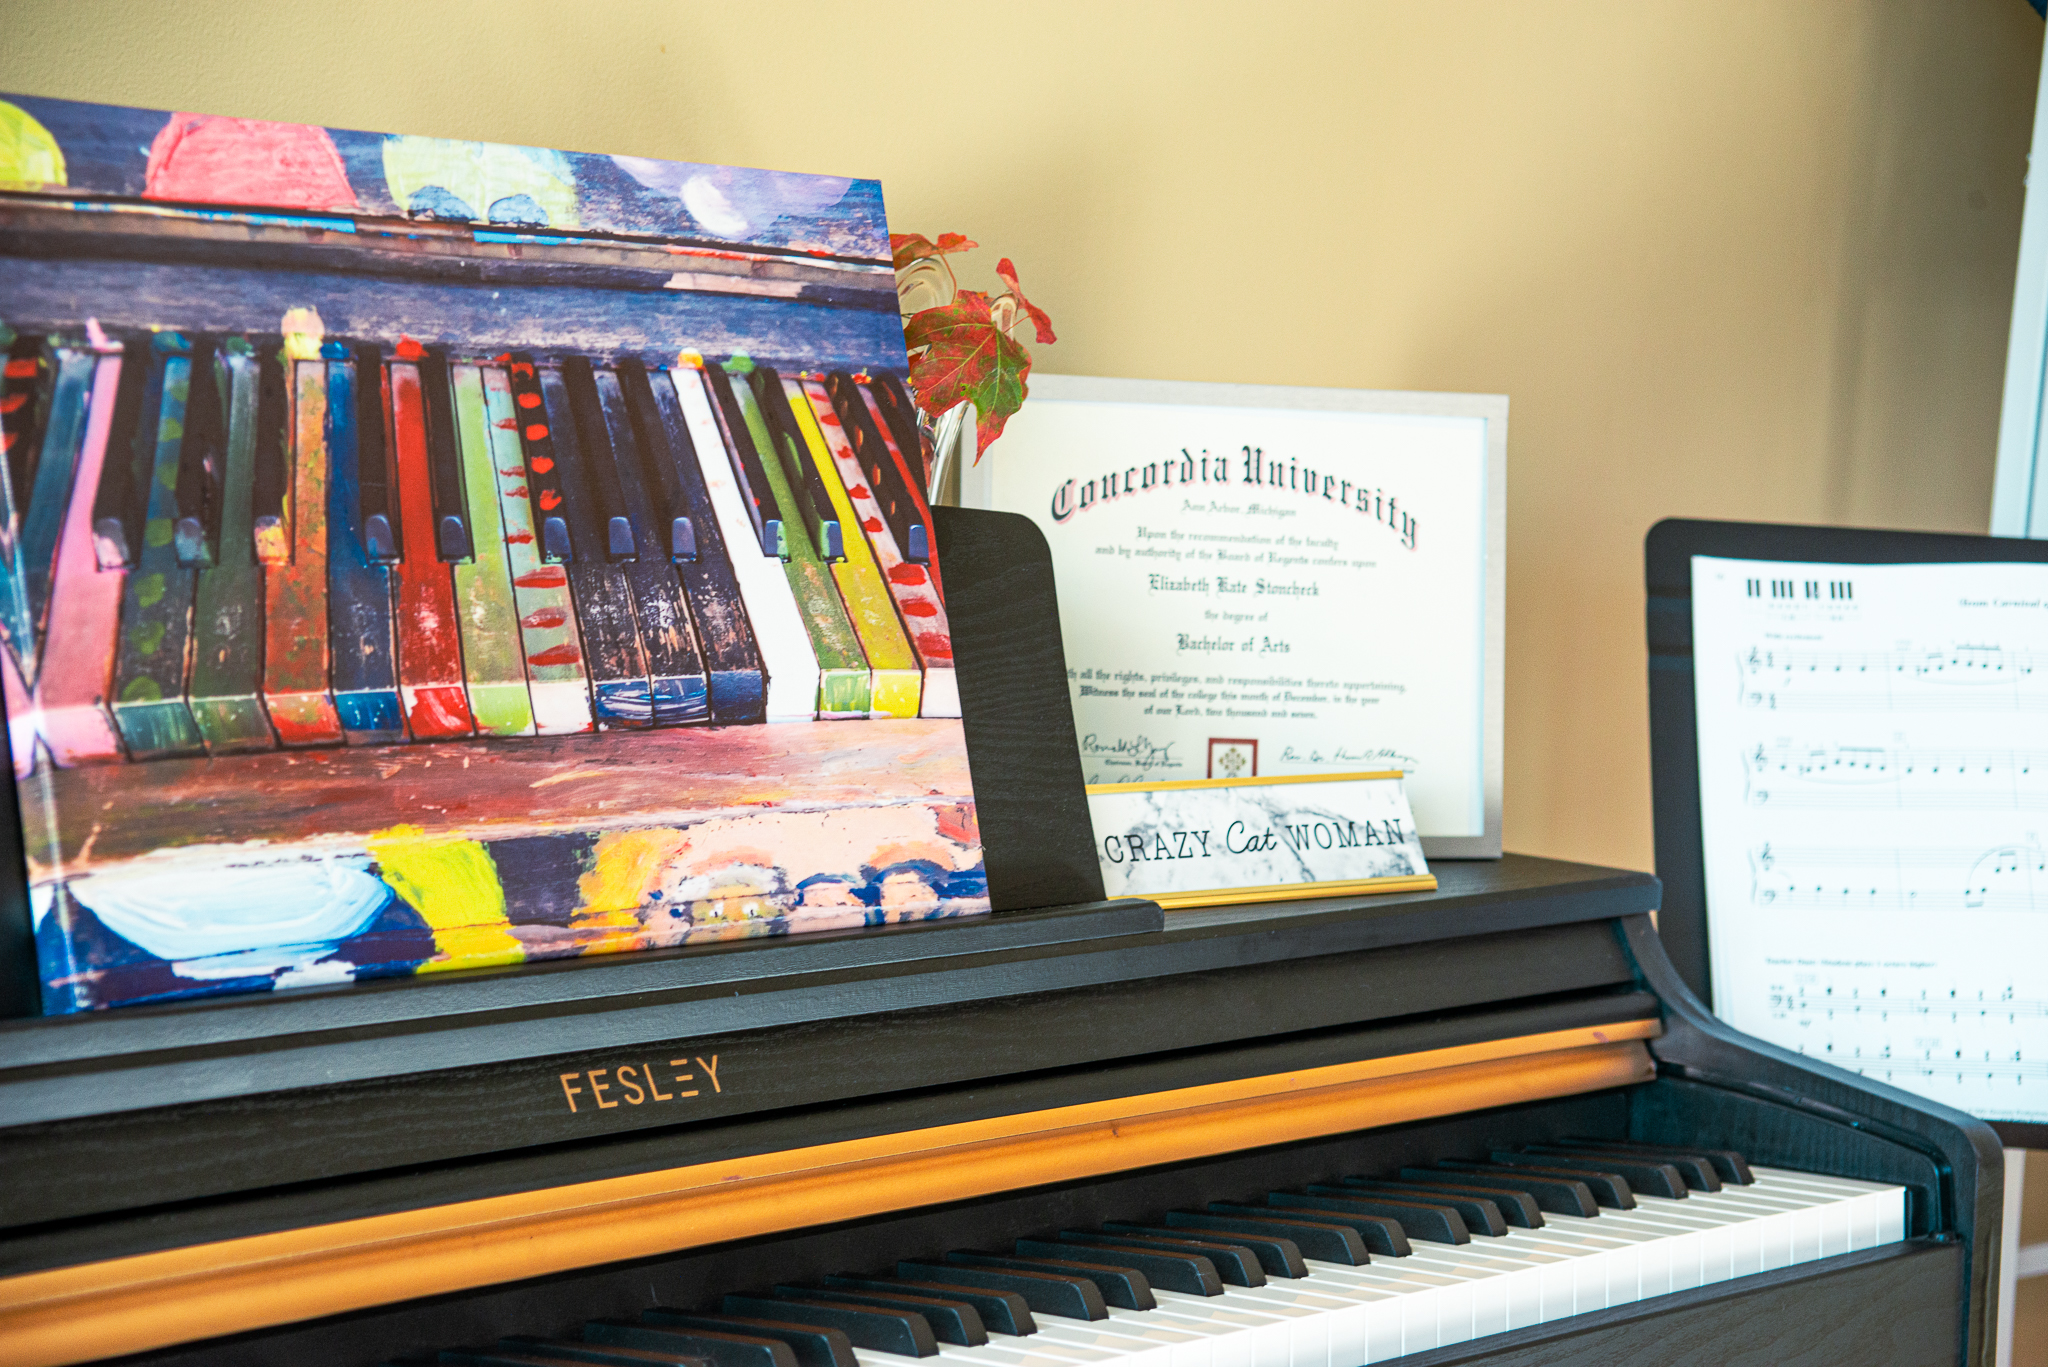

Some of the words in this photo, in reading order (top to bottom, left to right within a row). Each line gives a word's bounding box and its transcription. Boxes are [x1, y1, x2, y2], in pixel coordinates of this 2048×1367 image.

[1050, 447, 1229, 523] Concordia
[1241, 444, 1421, 551] University
[1148, 573, 1209, 597] Elizabeth
[1176, 632, 1234, 657] Bachelor
[1241, 636, 1254, 652] of
[1259, 636, 1290, 659] Arts
[1104, 830, 1212, 863] CRAZY
[1226, 820, 1278, 854] Cat
[1285, 818, 1406, 850] WOMAN
[560, 1054, 721, 1113] FESLEY
